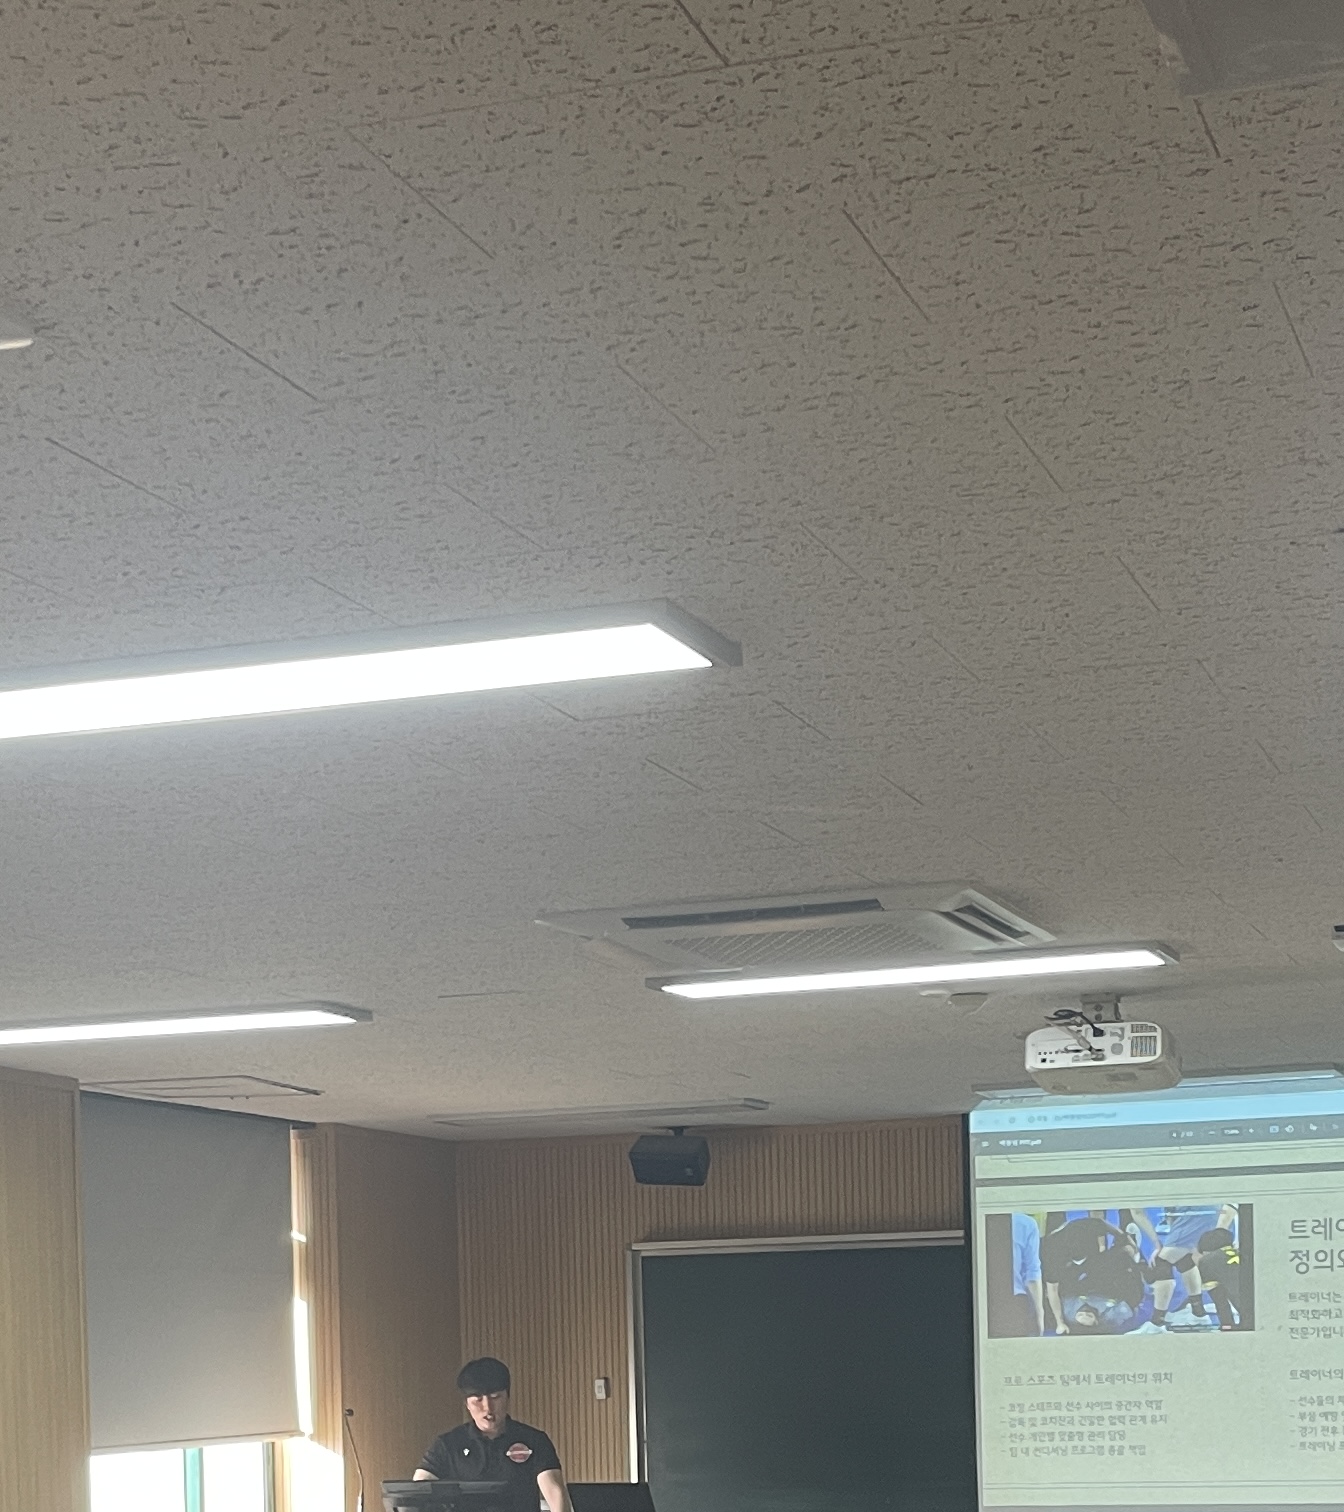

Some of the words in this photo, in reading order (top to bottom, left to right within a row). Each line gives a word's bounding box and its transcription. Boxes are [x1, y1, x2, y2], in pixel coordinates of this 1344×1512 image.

[1288, 1291, 1342, 1303] 트레이너는
[1288, 1308, 1343, 1320] 최적화하고
[1003, 1376, 1025, 1386] 프로
[1026, 1375, 1056, 1386] 스포츠
[1059, 1374, 1091, 1387] 팀에서
[1095, 1373, 1148, 1385] 트레이너의
[1152, 1372, 1173, 1384] 위치
[1289, 1368, 1344, 1380] 트레이너의
[1065, 1401, 1082, 1412] 선수
[1084, 1401, 1113, 1411] 사이의
[1298, 1395, 1334, 1407] 선수들의
[1298, 1411, 1316, 1422] 부상
[1318, 1411, 1338, 1422] 예방
[1087, 1430, 1106, 1442] 관리
[1298, 1425, 1317, 1437] 경기
[1320, 1425, 1339, 1437] 전후
[1070, 1445, 1105, 1456] 프로그램
[1298, 1440, 1335, 1452] 트레이닝
